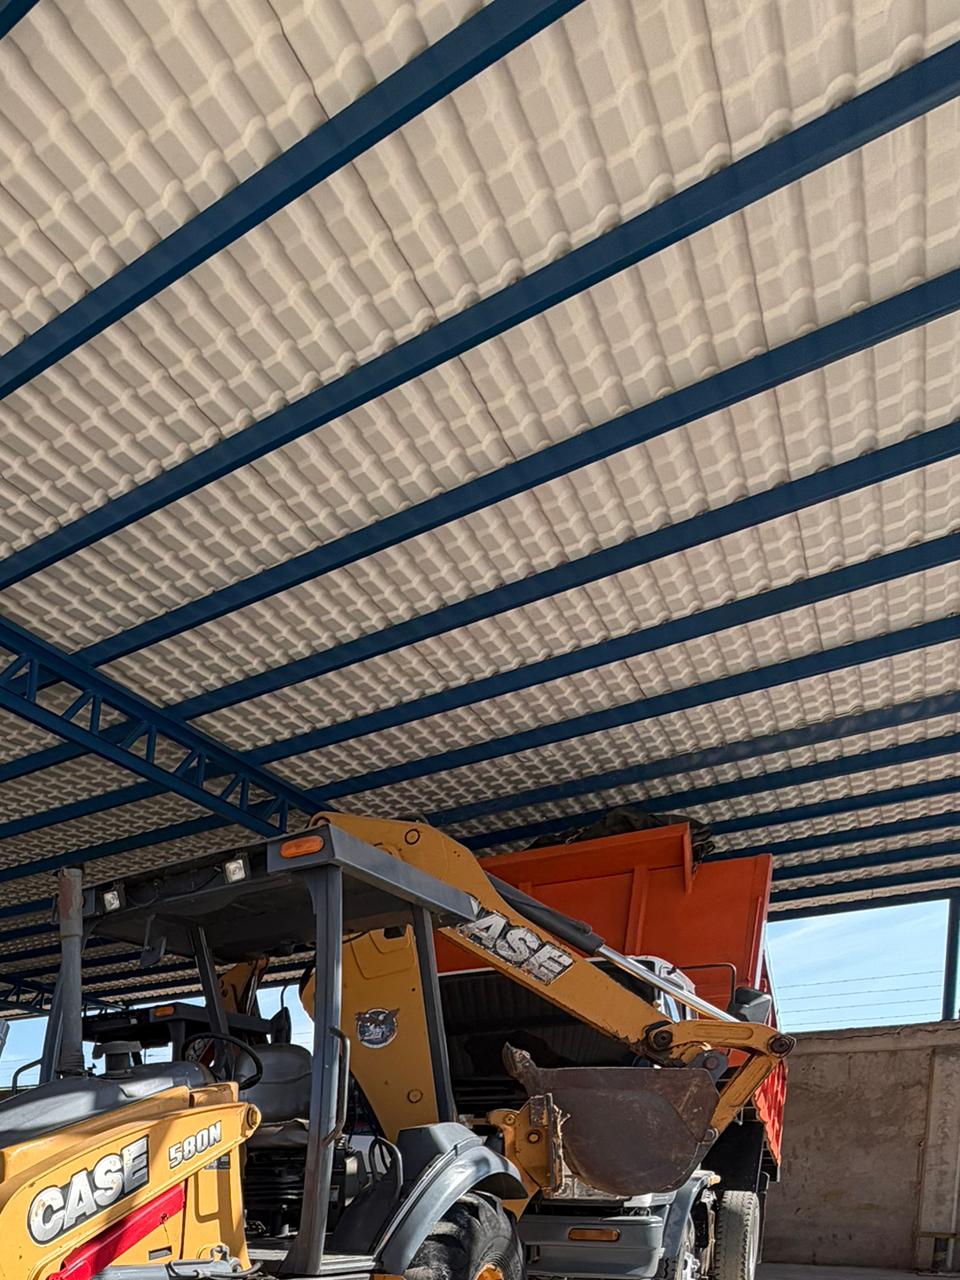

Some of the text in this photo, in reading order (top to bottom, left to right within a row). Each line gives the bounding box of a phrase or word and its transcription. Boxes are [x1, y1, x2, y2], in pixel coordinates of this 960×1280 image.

[460, 900, 574, 983] ASE
[168, 1120, 221, 1169] 580N
[28, 1135, 149, 1244] CASE
